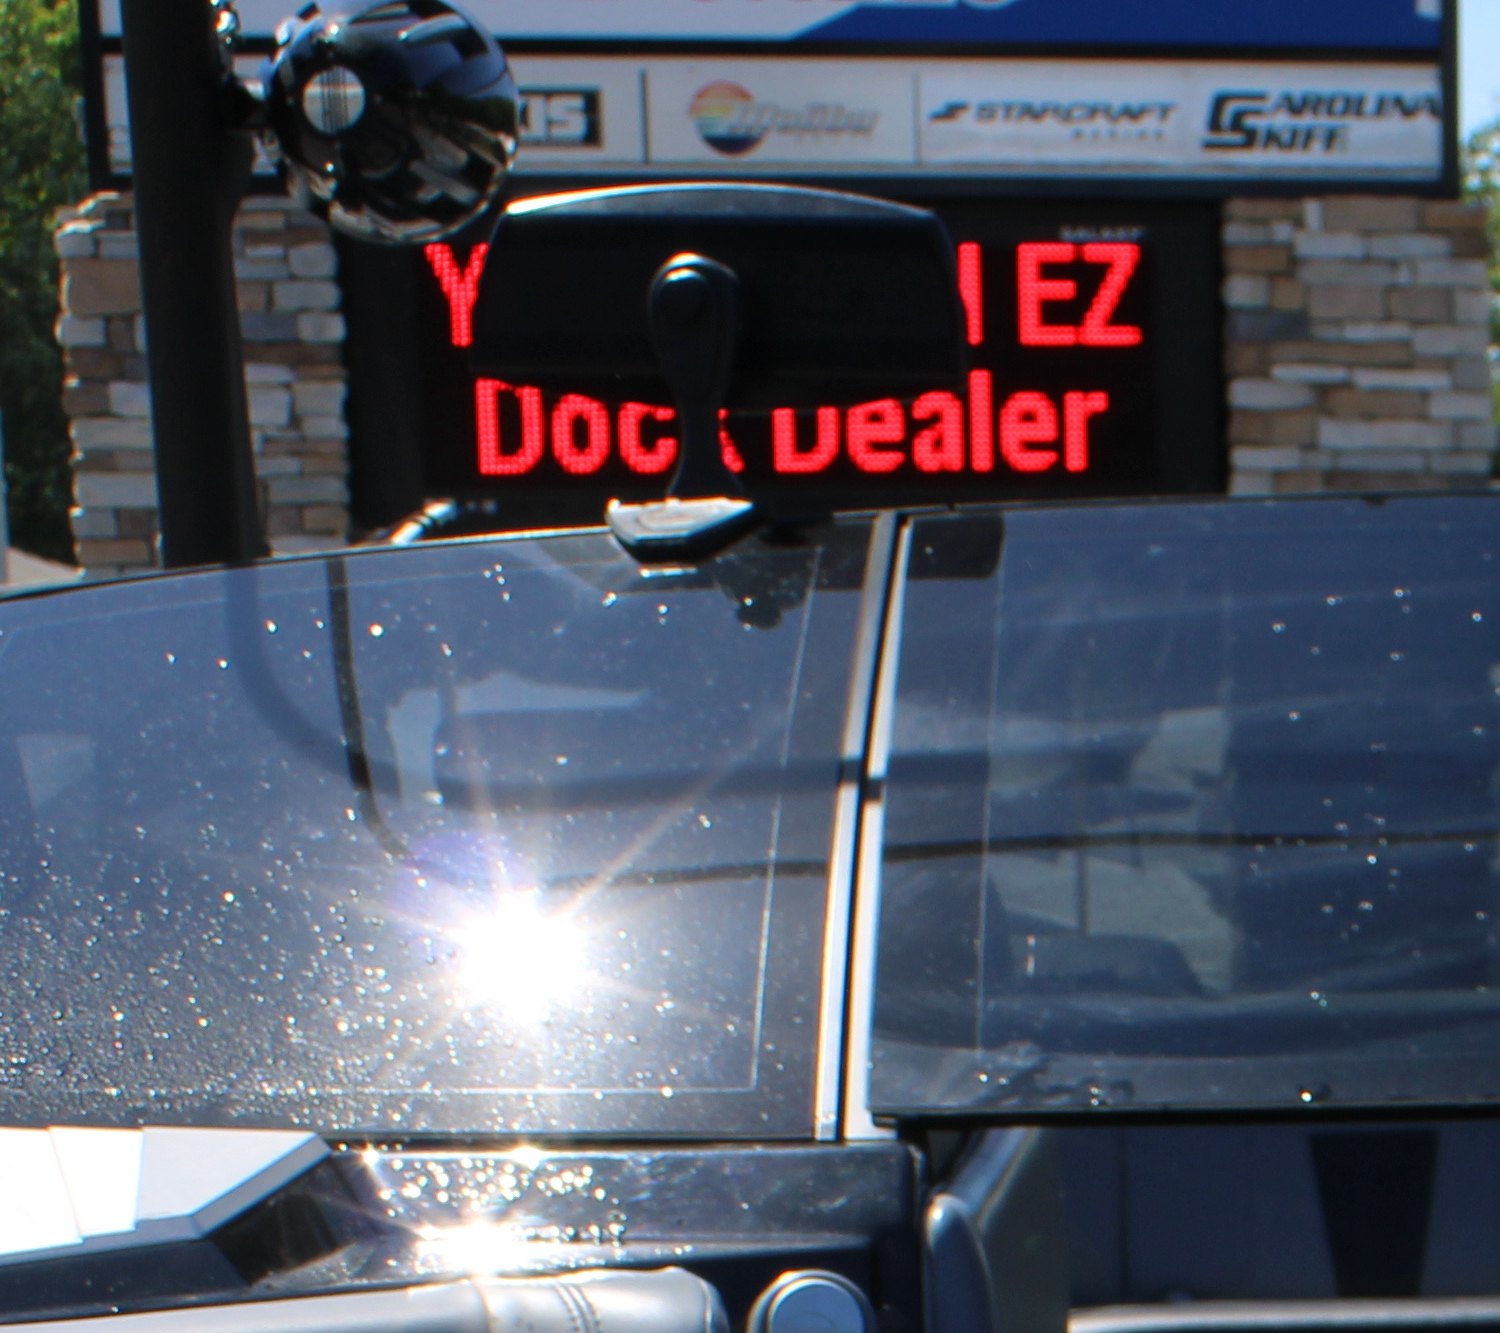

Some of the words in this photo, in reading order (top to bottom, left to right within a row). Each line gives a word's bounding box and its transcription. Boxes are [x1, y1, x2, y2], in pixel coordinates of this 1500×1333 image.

[974, 100, 1182, 126] STARCRAFT
[1207, 88, 1442, 132] CAROLINA
[1016, 241, 1143, 347] EZ
[771, 368, 1109, 474] Dealer
